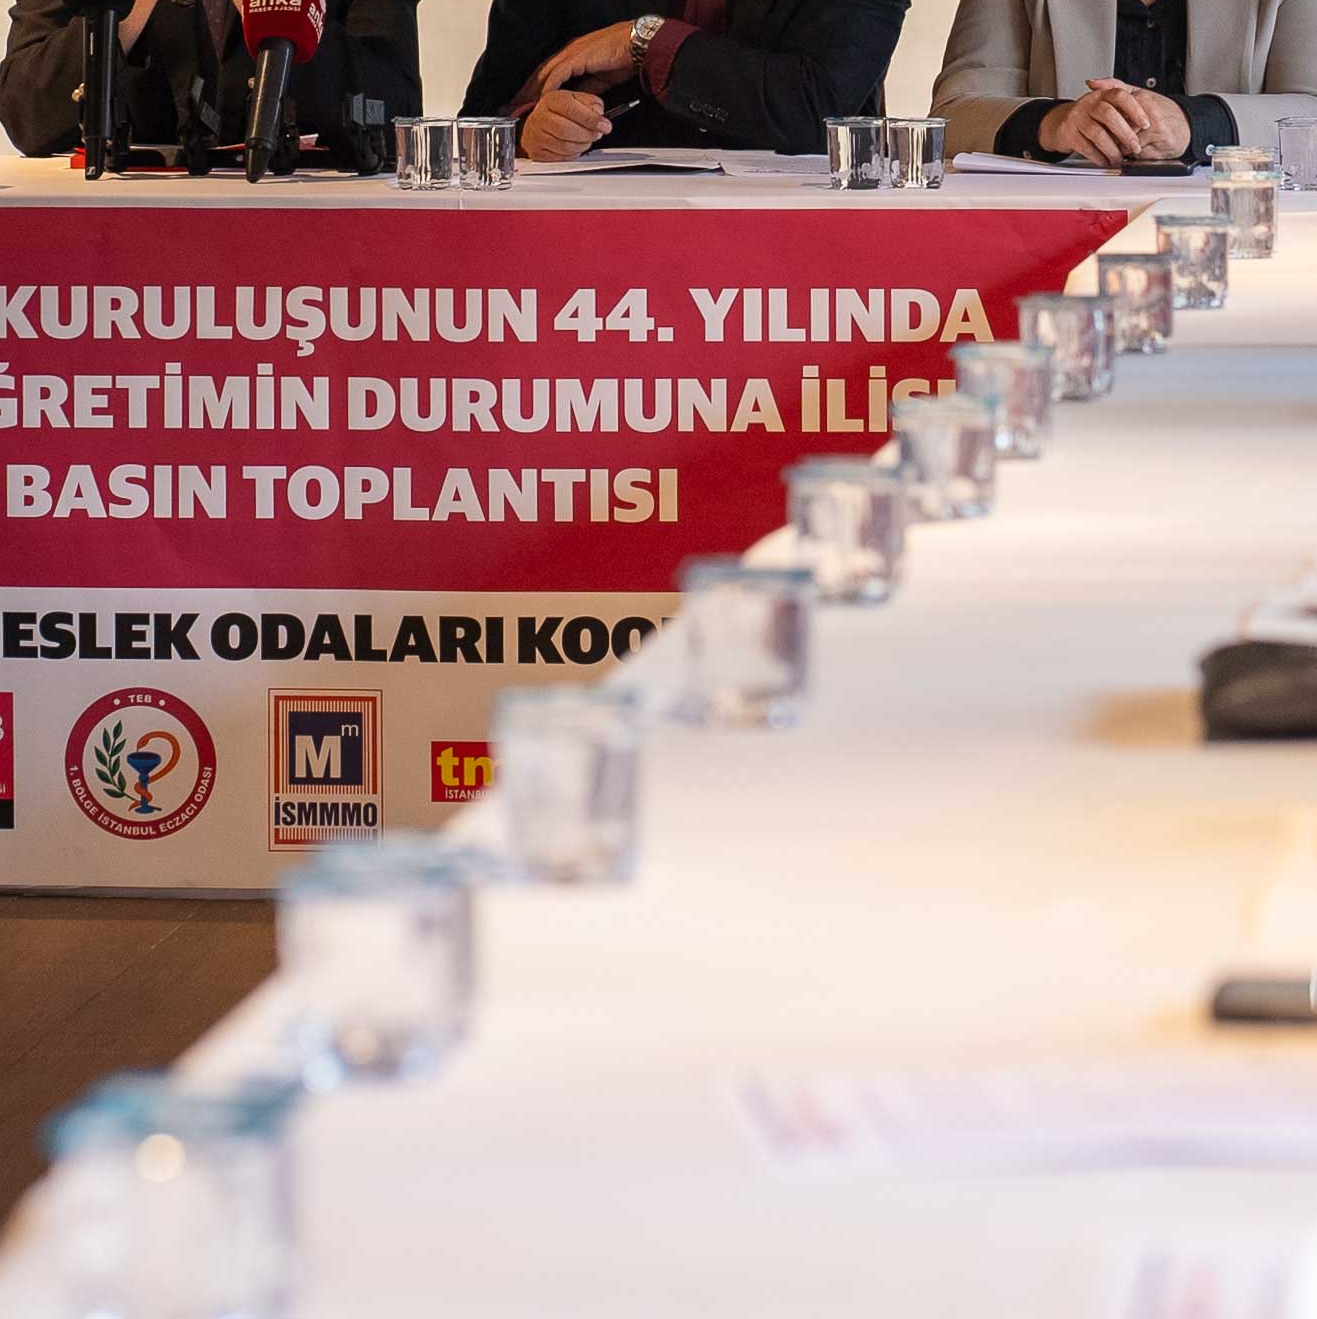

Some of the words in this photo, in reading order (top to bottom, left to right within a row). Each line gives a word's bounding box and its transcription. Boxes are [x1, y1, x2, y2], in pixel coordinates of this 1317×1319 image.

[553, 287, 674, 343] 44.
[689, 287, 995, 344] YILINDA
[347, 376, 785, 433] DURUMUNA
[6, 464, 227, 519] BASIN
[242, 465, 678, 523] TOPLANTISI
[210, 611, 504, 664] ODALARI
[517, 615, 675, 666] KOO
[128, 694, 152, 703] TEB
[97, 812, 156, 836] İSTANBUL
[159, 803, 198, 833] ECZACI
[195, 766, 213, 802] ODASI
[273, 795, 378, 827] İSMMMO
